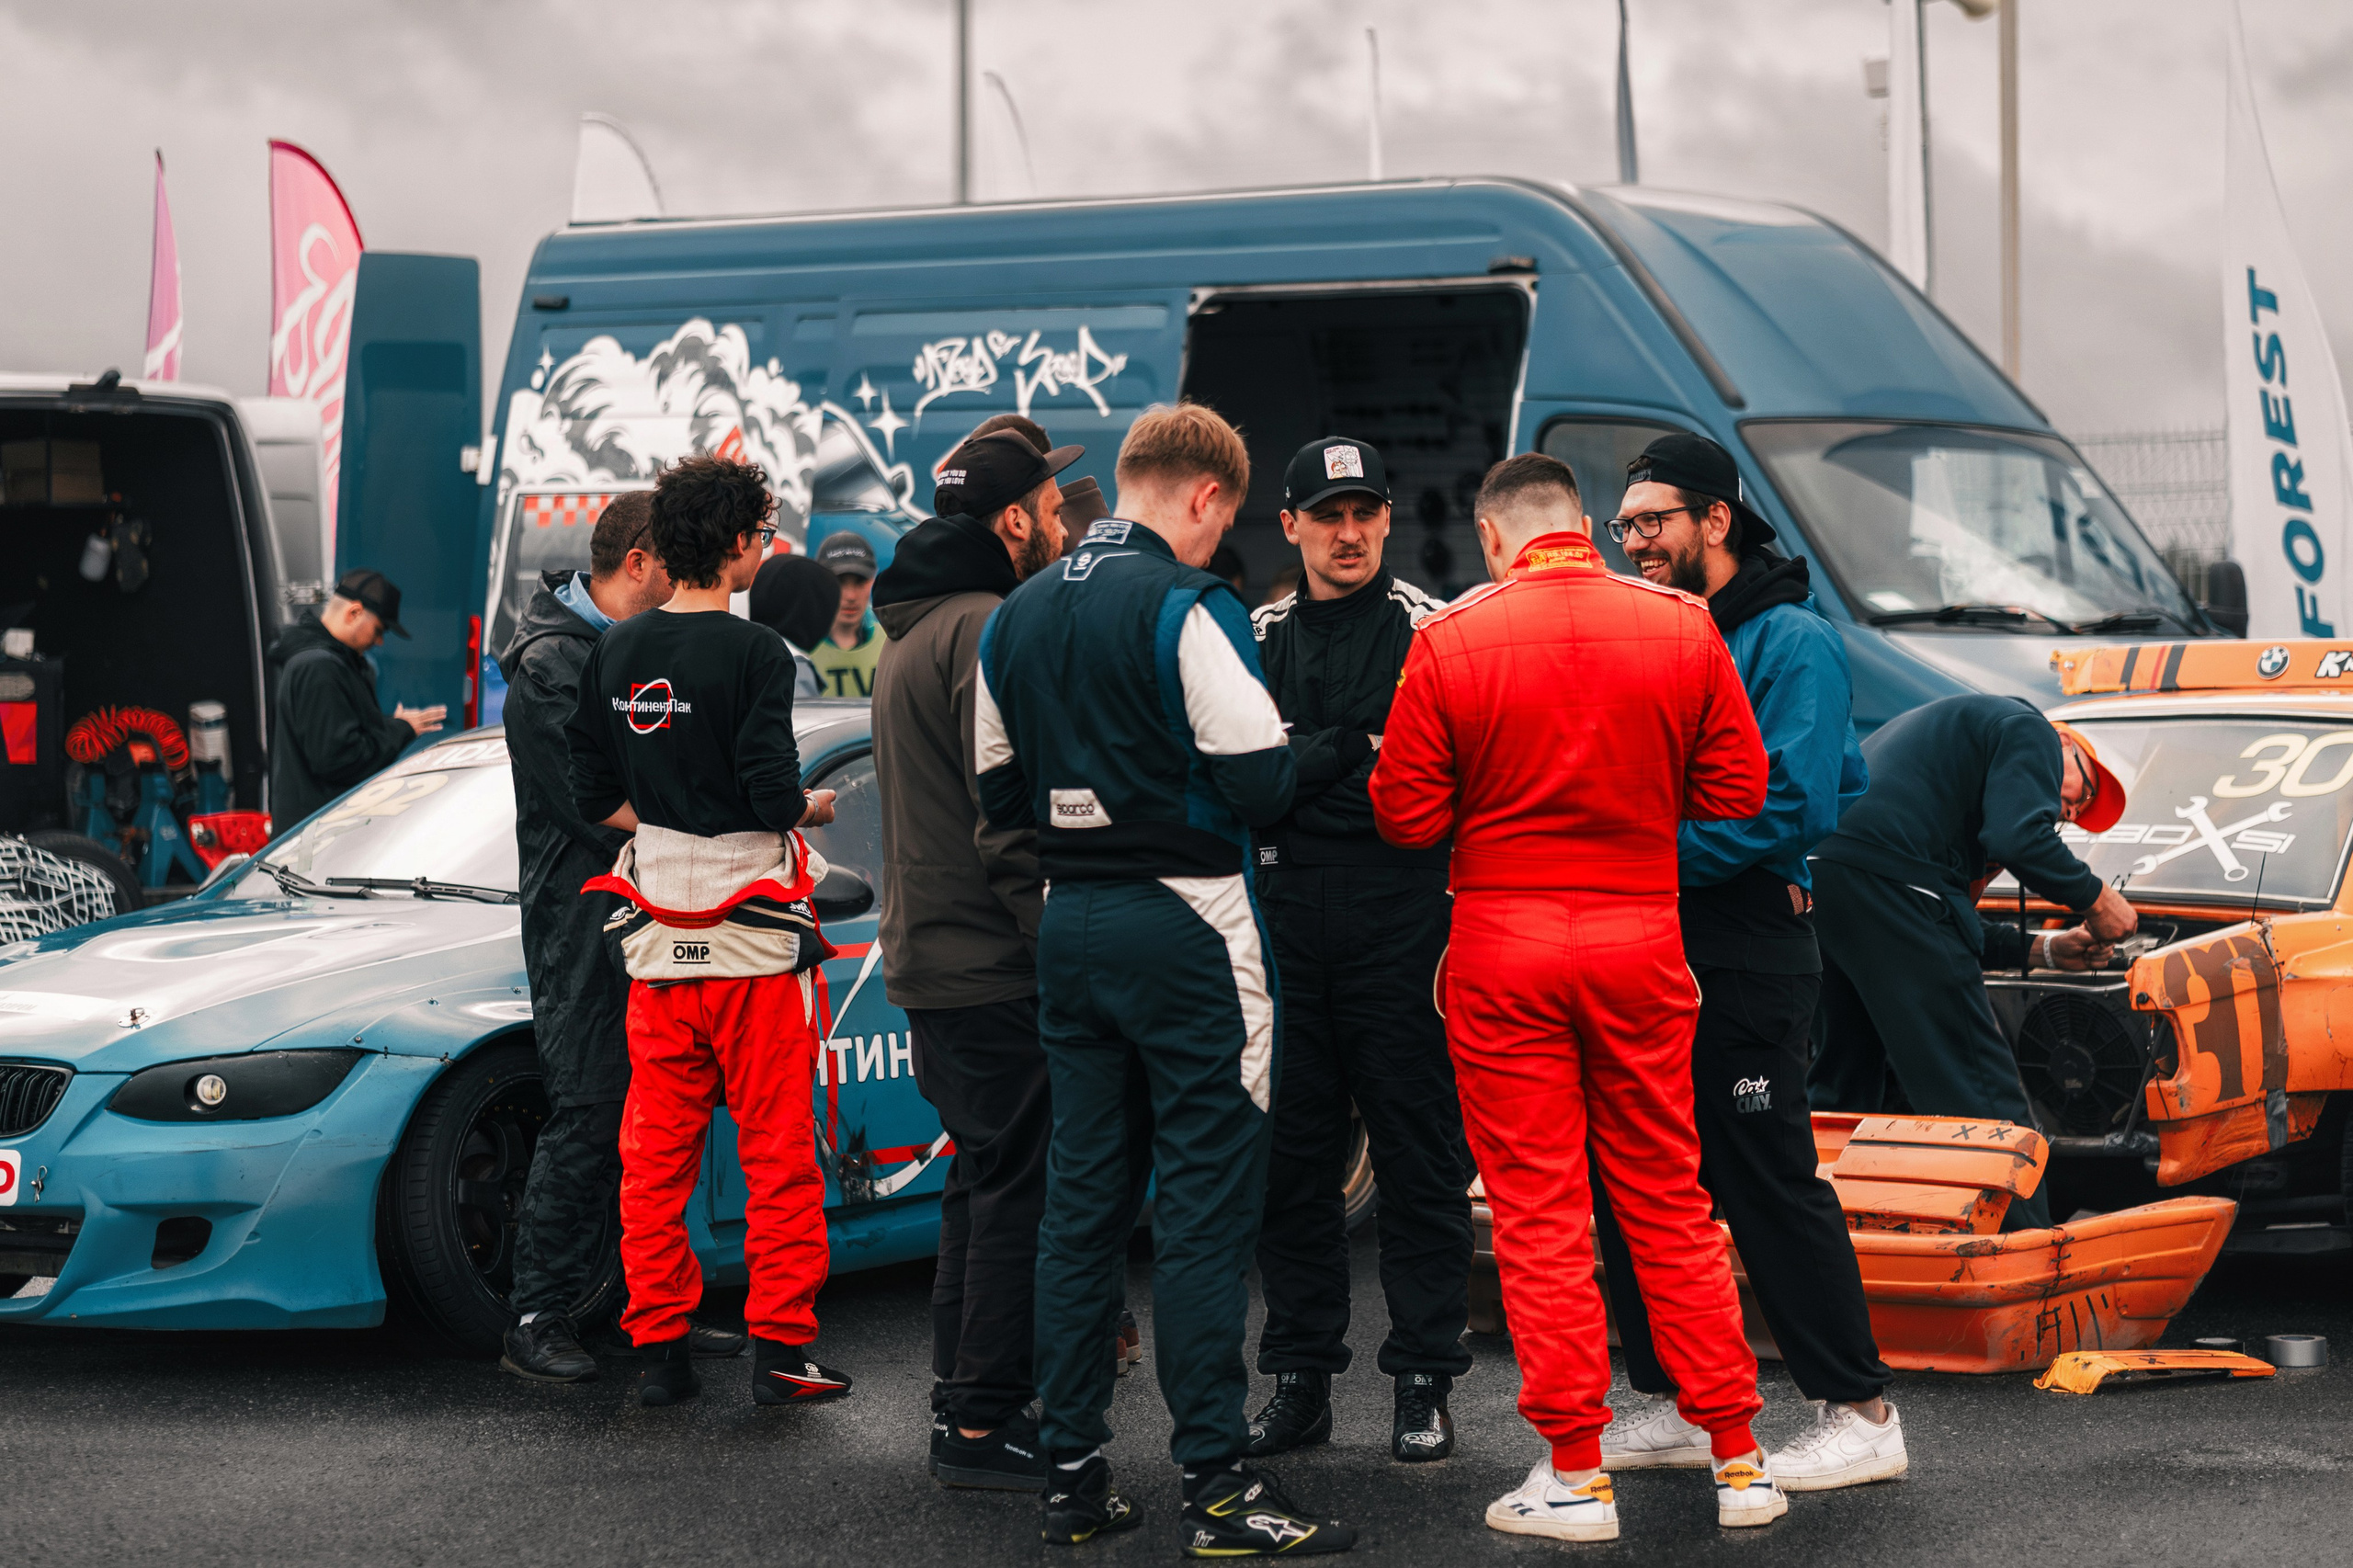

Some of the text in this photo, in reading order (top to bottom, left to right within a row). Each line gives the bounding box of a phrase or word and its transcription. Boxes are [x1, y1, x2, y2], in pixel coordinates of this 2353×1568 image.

[2246, 266, 2335, 639] FOREST
[612, 697, 691, 713] КонтинентПак
[2212, 731, 2353, 798] 30
[1259, 849, 1278, 863] OMP
[673, 944, 710, 961] OMP
[1405, 1434, 1444, 1446] OMP
[1005, 1443, 1027, 1457] Reebok
[1724, 1471, 1754, 1479] Reebok
